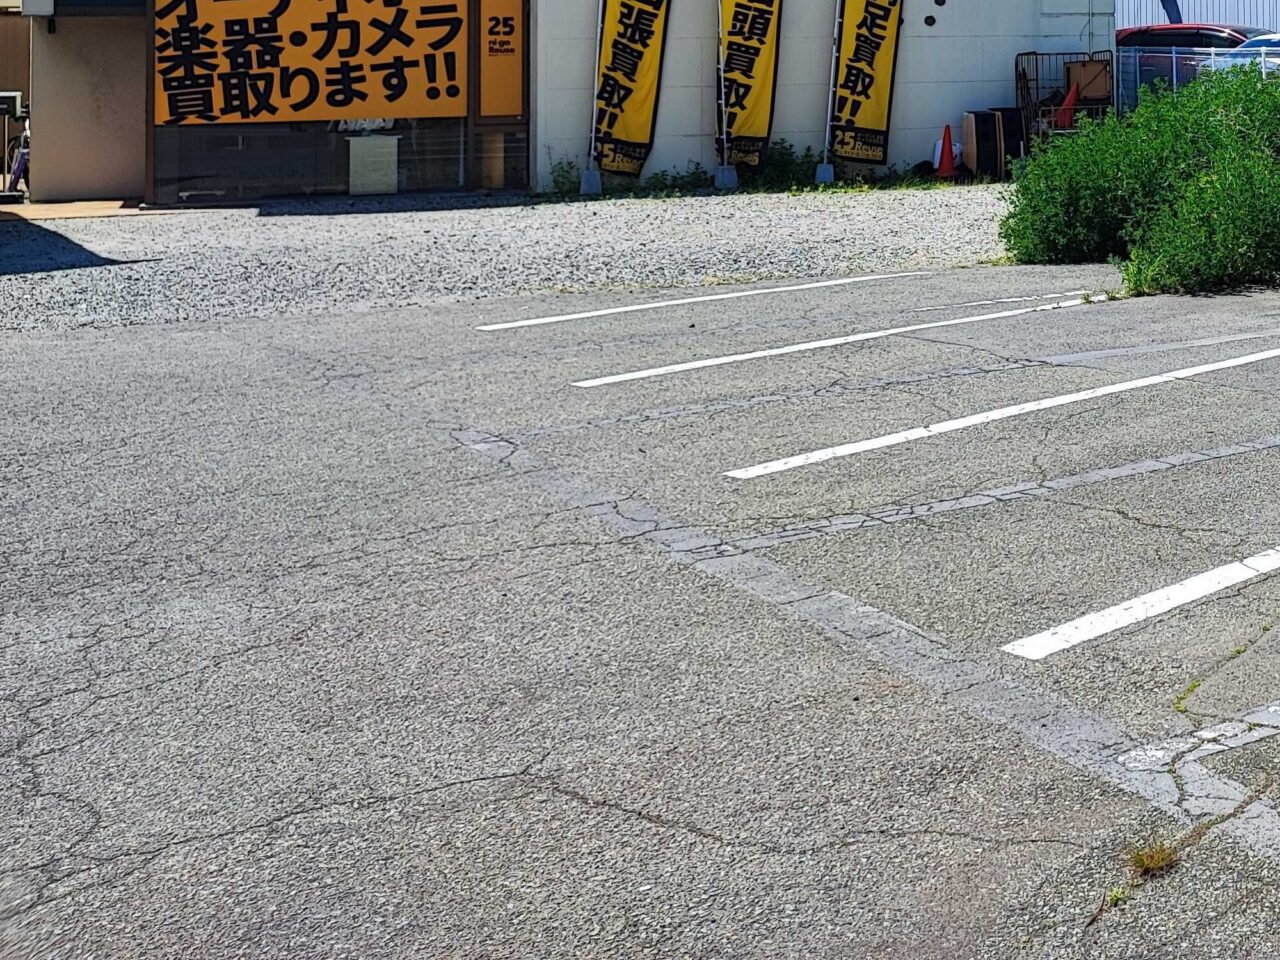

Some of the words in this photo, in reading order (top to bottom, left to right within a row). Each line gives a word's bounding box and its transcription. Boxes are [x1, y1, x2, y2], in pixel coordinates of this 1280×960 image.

[154, 4, 464, 78] 楽器・カメラ
[488, 16, 515, 36] 25
[163, 52, 460, 125] 買取ります!!
[833, 130, 855, 151] 25
